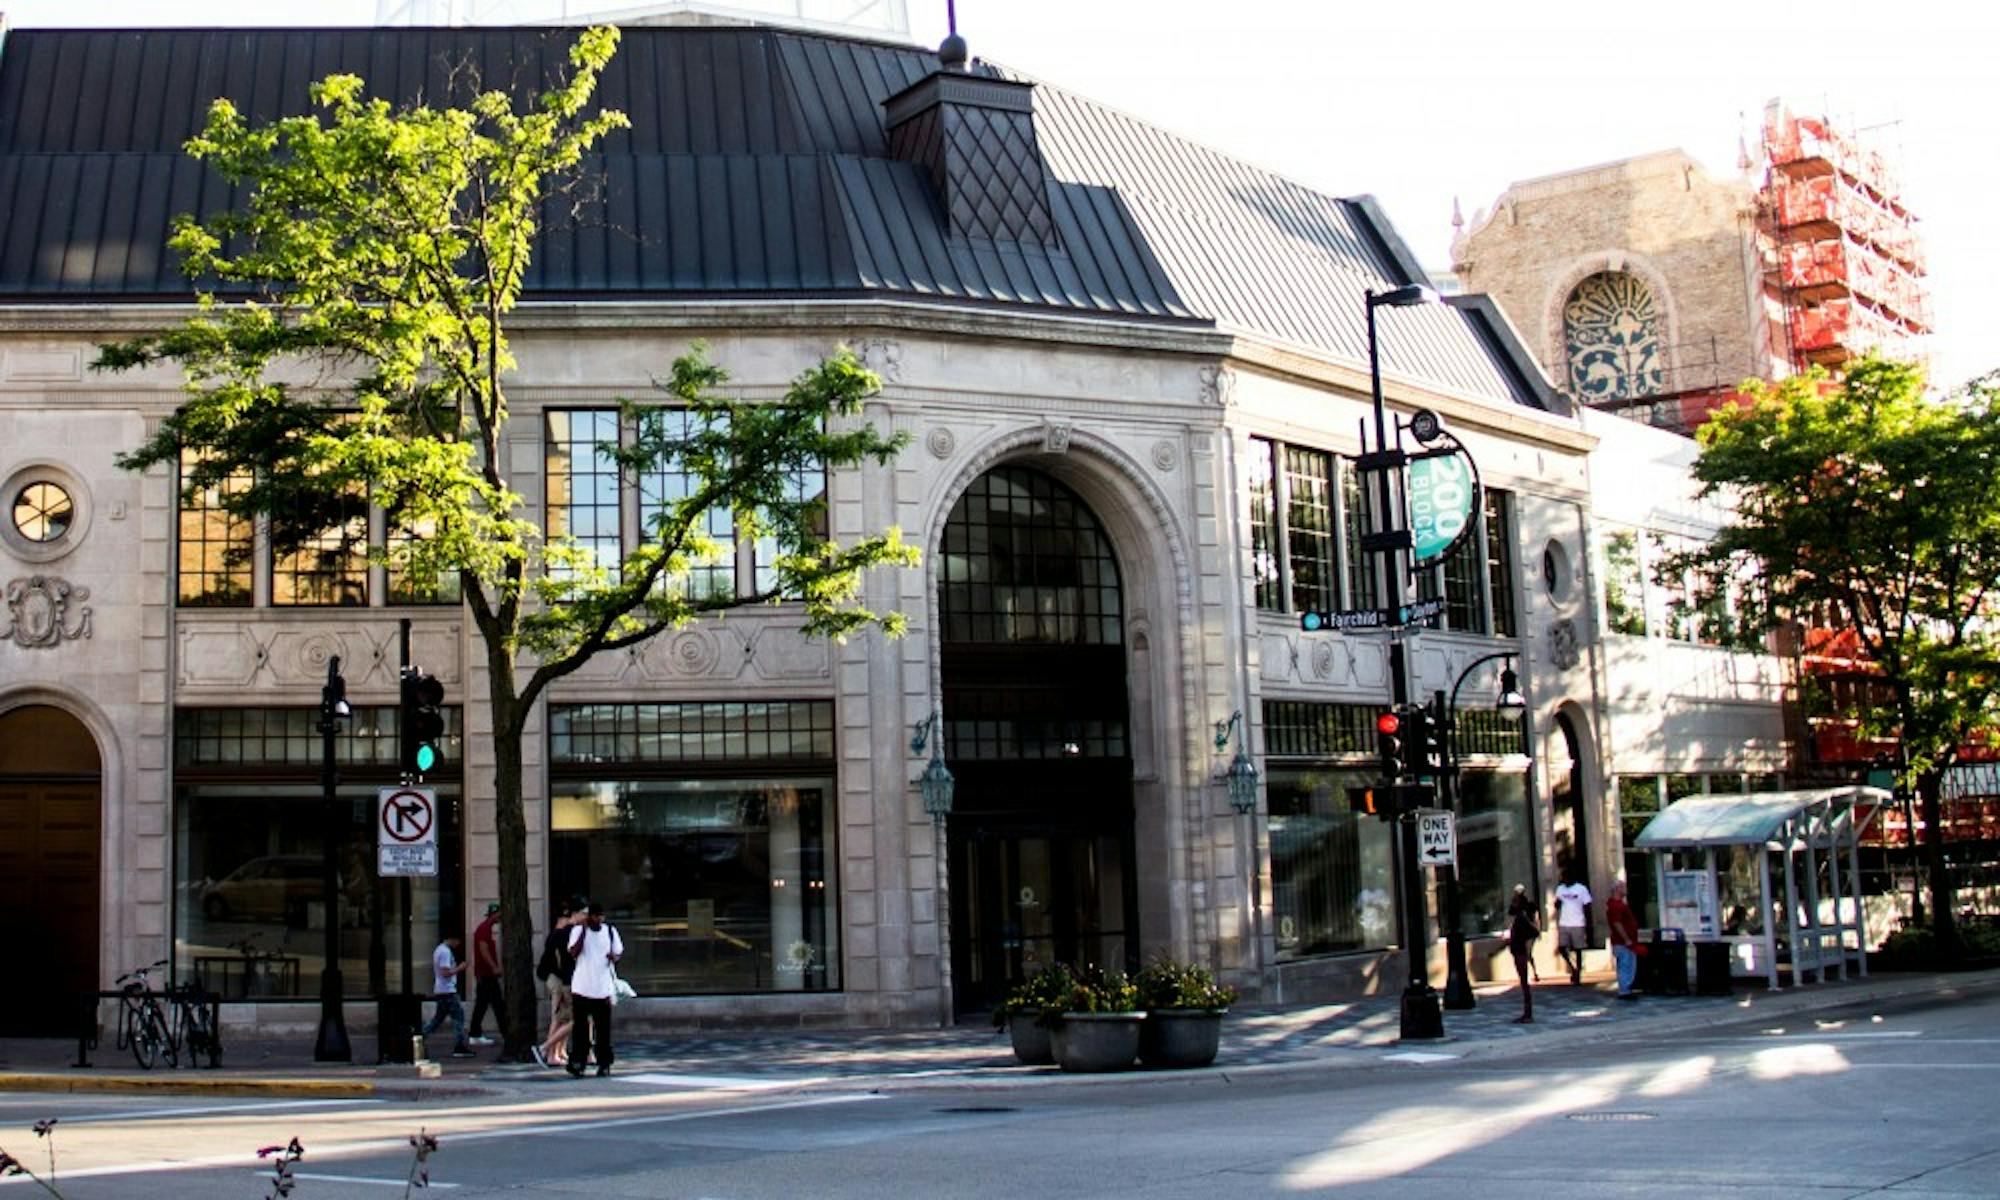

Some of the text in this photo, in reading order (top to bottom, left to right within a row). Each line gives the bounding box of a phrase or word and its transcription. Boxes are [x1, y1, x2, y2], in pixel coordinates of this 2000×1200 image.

[1431, 455, 1465, 538] 200
[1413, 476, 1435, 543] BLOCK
[1331, 611, 1377, 627] Fairchild
[1423, 817, 1448, 831] ONE
[1424, 832, 1448, 844] WAY
